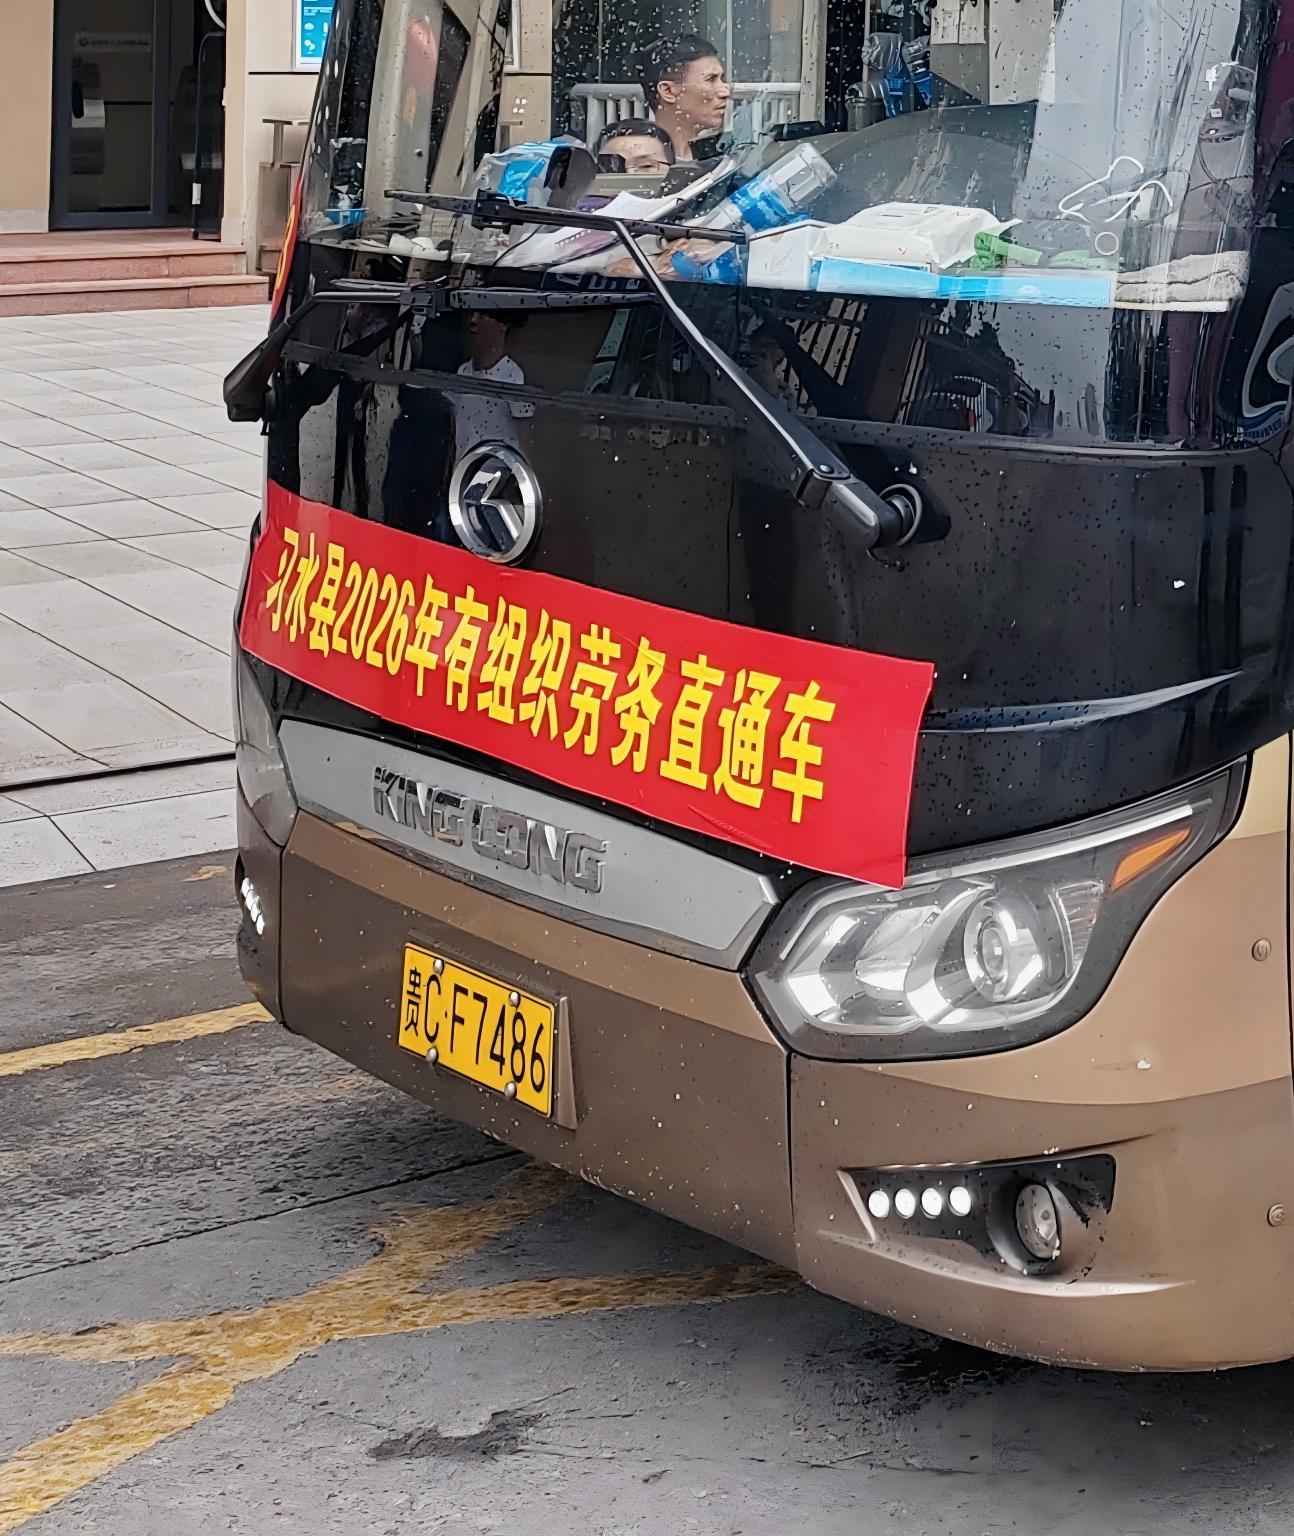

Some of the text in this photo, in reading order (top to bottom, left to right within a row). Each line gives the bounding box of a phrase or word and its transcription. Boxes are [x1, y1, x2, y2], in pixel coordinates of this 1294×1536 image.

[266, 526, 837, 824] 习水县2026年有组织劳务直通车
[373, 766, 610, 894] KING LONG
